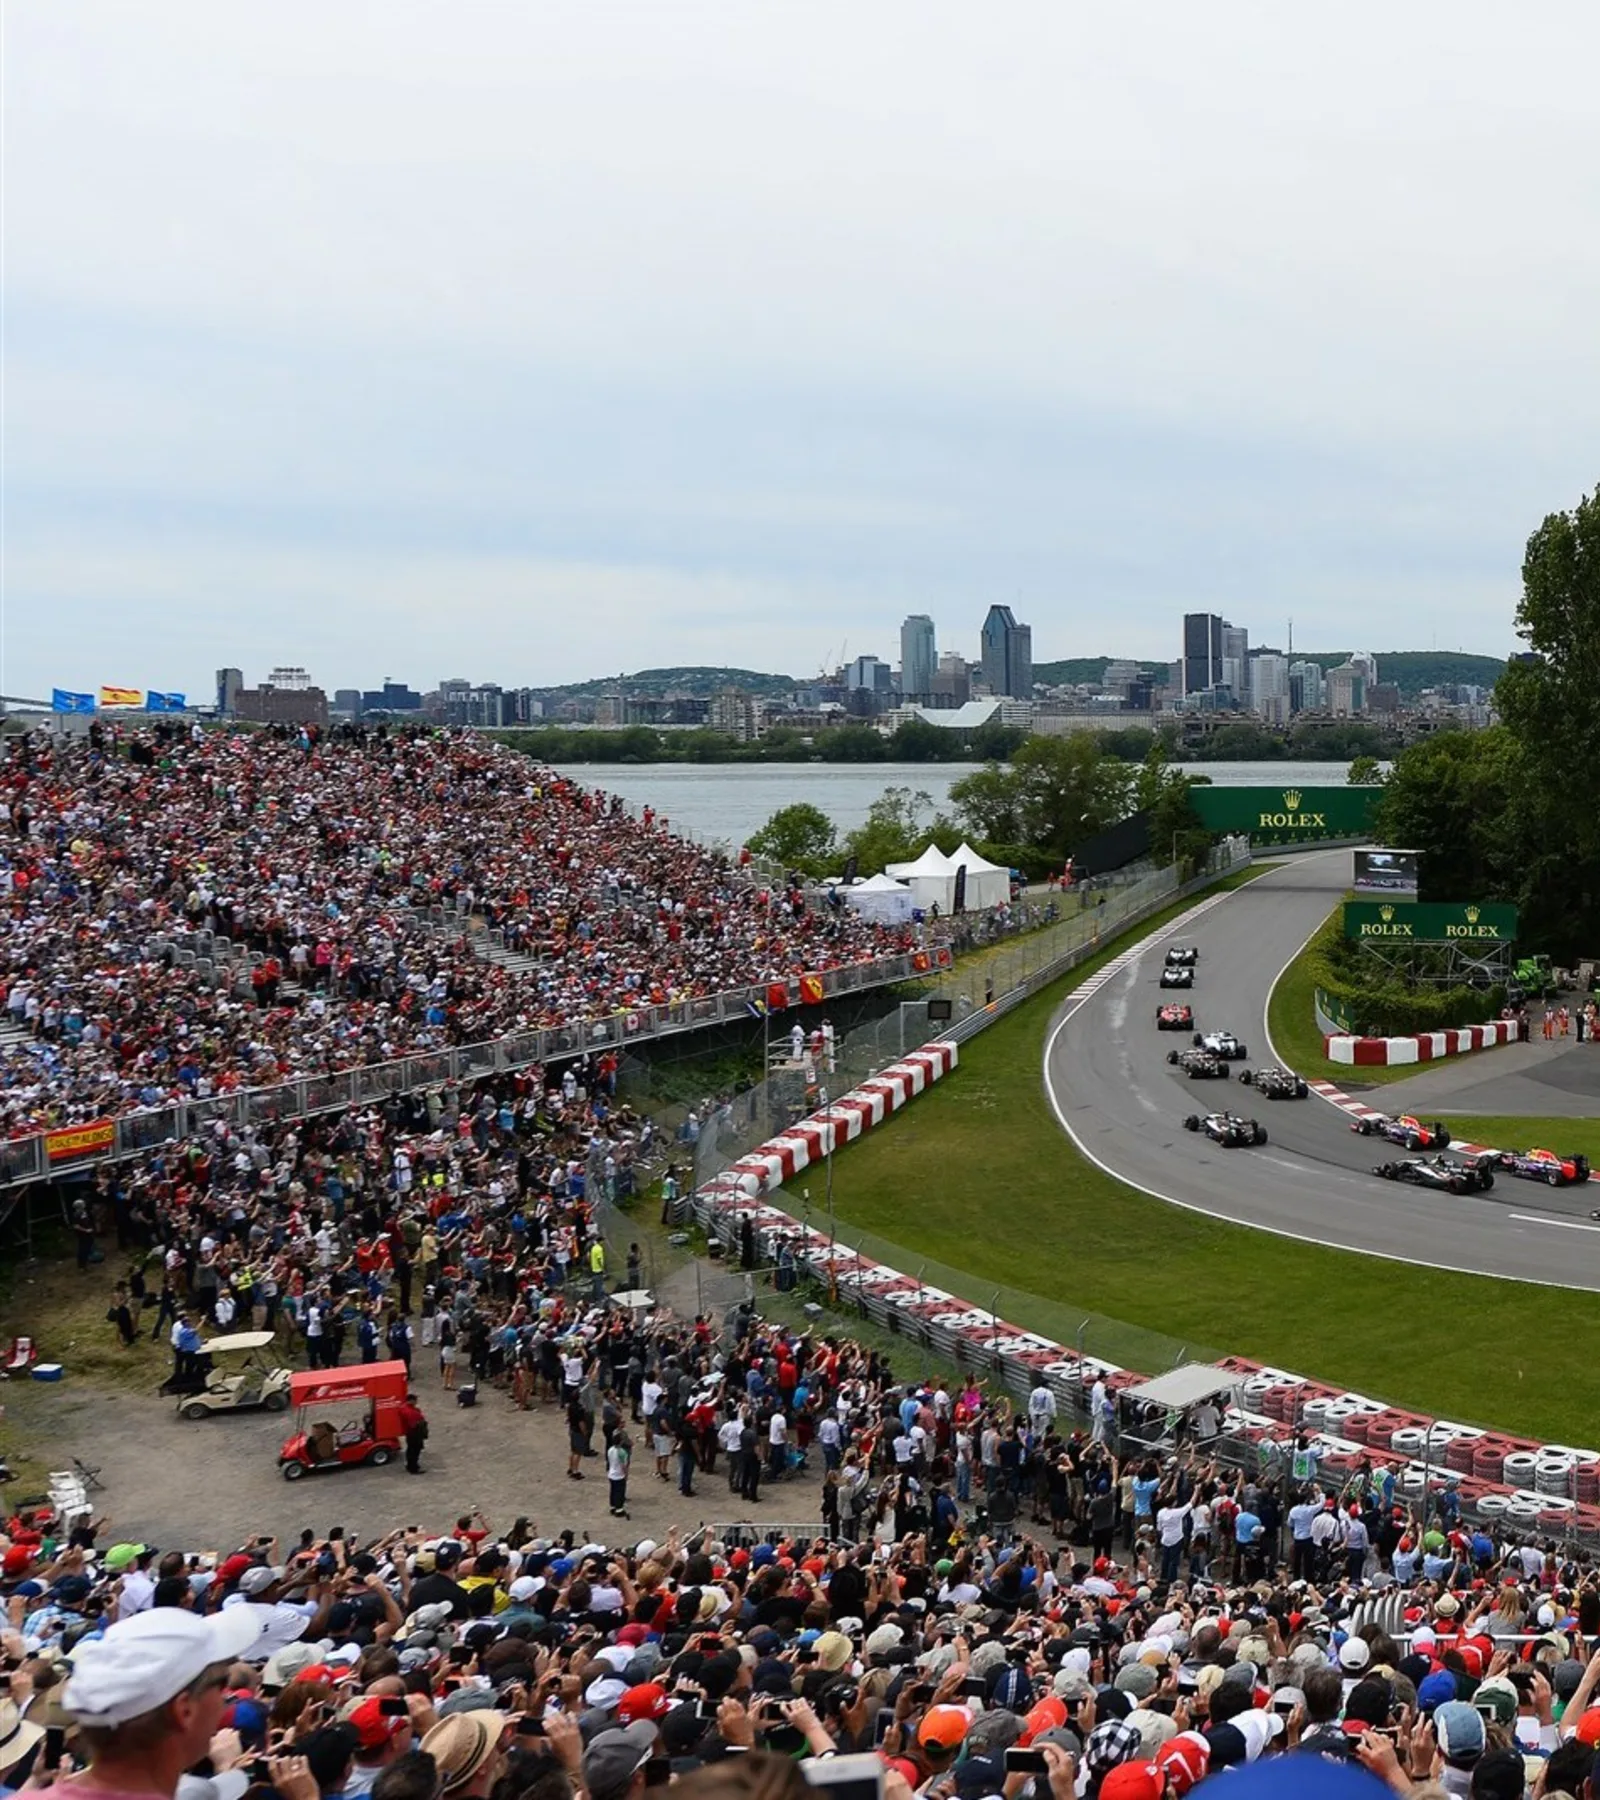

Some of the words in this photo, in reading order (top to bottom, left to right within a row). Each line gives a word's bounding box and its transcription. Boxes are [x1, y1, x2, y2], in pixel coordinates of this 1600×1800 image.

[1259, 813, 1326, 828] ROLEX
[1360, 923, 1413, 936] ROLEX
[1446, 925, 1499, 937] ROLEX
